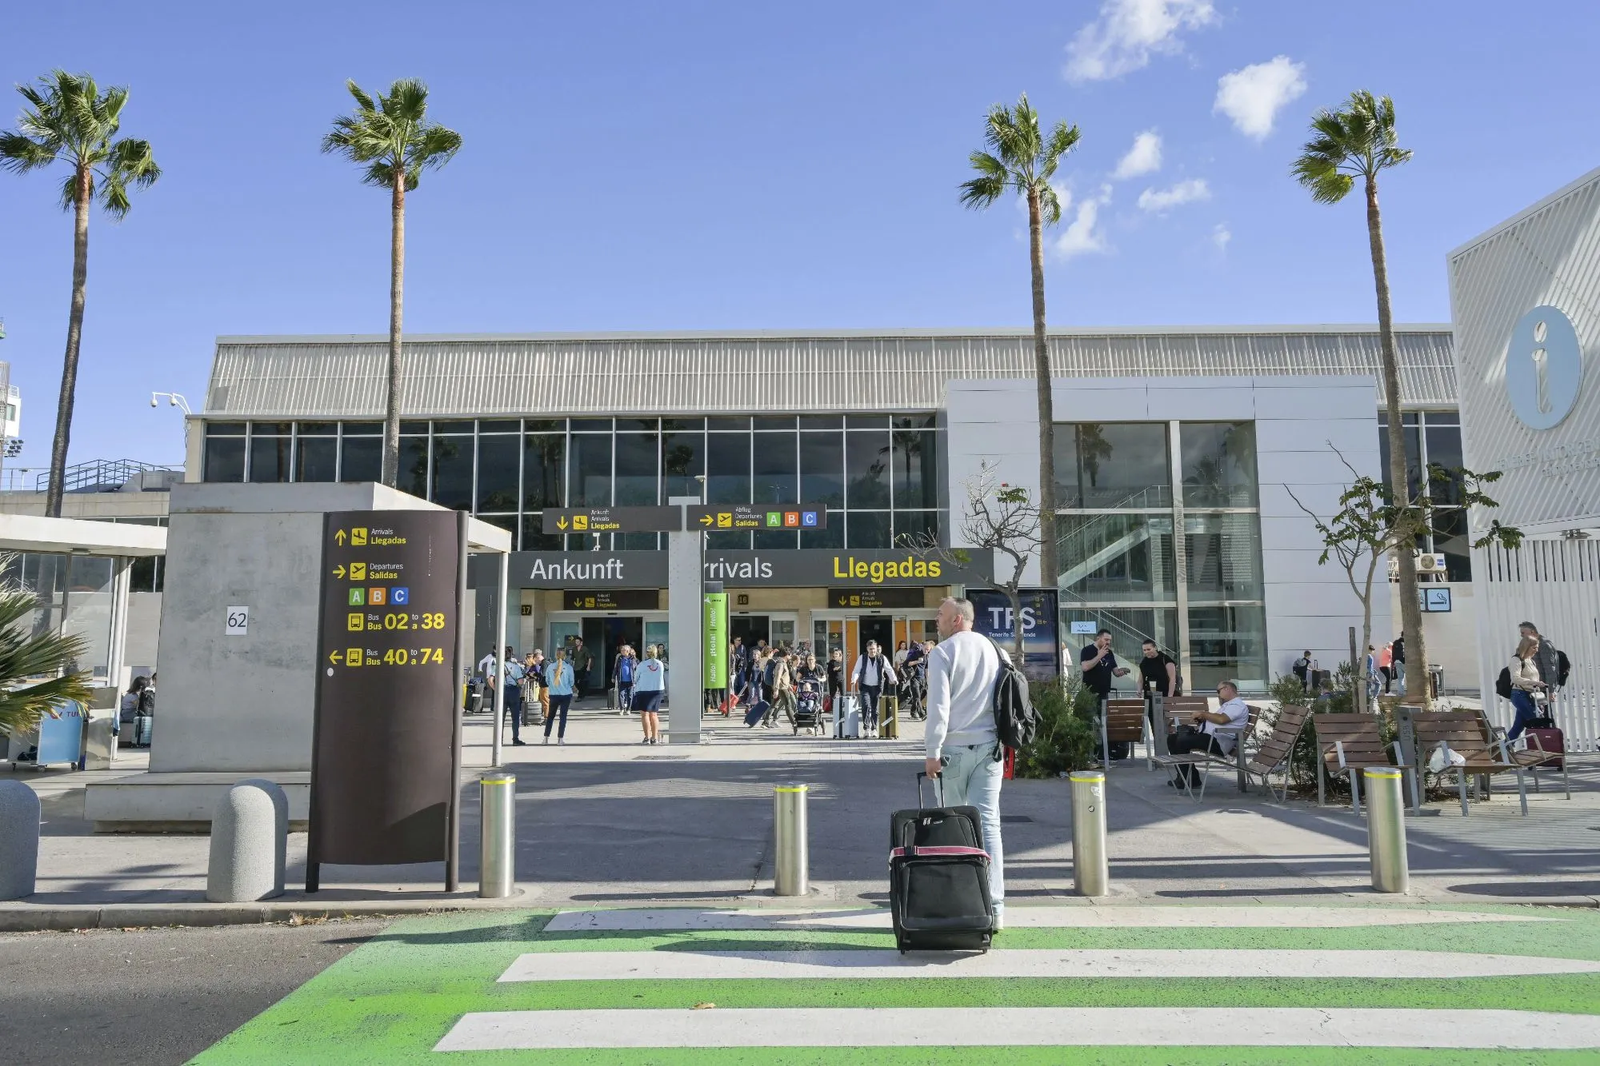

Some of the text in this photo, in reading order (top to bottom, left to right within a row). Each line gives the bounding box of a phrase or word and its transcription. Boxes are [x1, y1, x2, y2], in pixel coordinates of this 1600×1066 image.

[770, 514, 814, 524] A B C
[590, 522, 620, 530] Llegadas
[370, 536, 407, 546] Llegadas
[369, 562, 404, 571] Departures
[530, 558, 624, 580] Ankunft
[833, 556, 941, 583] Llegadas
[369, 571, 398, 579] Salidas
[352, 590, 405, 602] A B C
[522, 606, 531, 614] 17
[227, 612, 247, 628] 62
[367, 613, 380, 621] Bus
[367, 622, 382, 630] Bus
[384, 613, 409, 630] 02
[421, 613, 445, 630] 38
[366, 657, 381, 666] Bus
[383, 648, 408, 666] 40
[420, 648, 444, 665] 74
